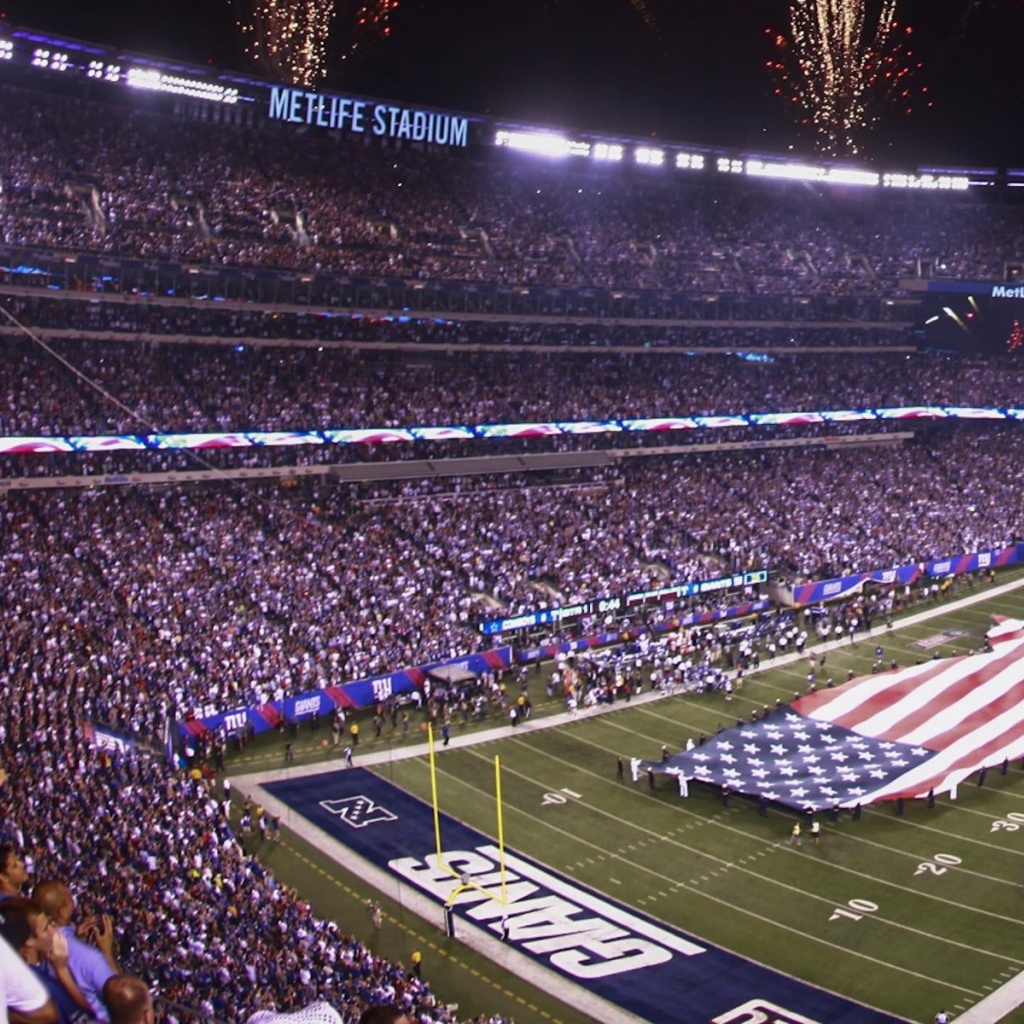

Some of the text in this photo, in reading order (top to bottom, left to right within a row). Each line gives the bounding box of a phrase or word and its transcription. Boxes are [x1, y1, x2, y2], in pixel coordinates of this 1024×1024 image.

[269, 87, 469, 147] METLIFE STADIUM
[543, 787, 582, 804] 10
[918, 853, 962, 876] 20
[388, 845, 707, 979] GIANTS
[834, 898, 879, 922] 10
